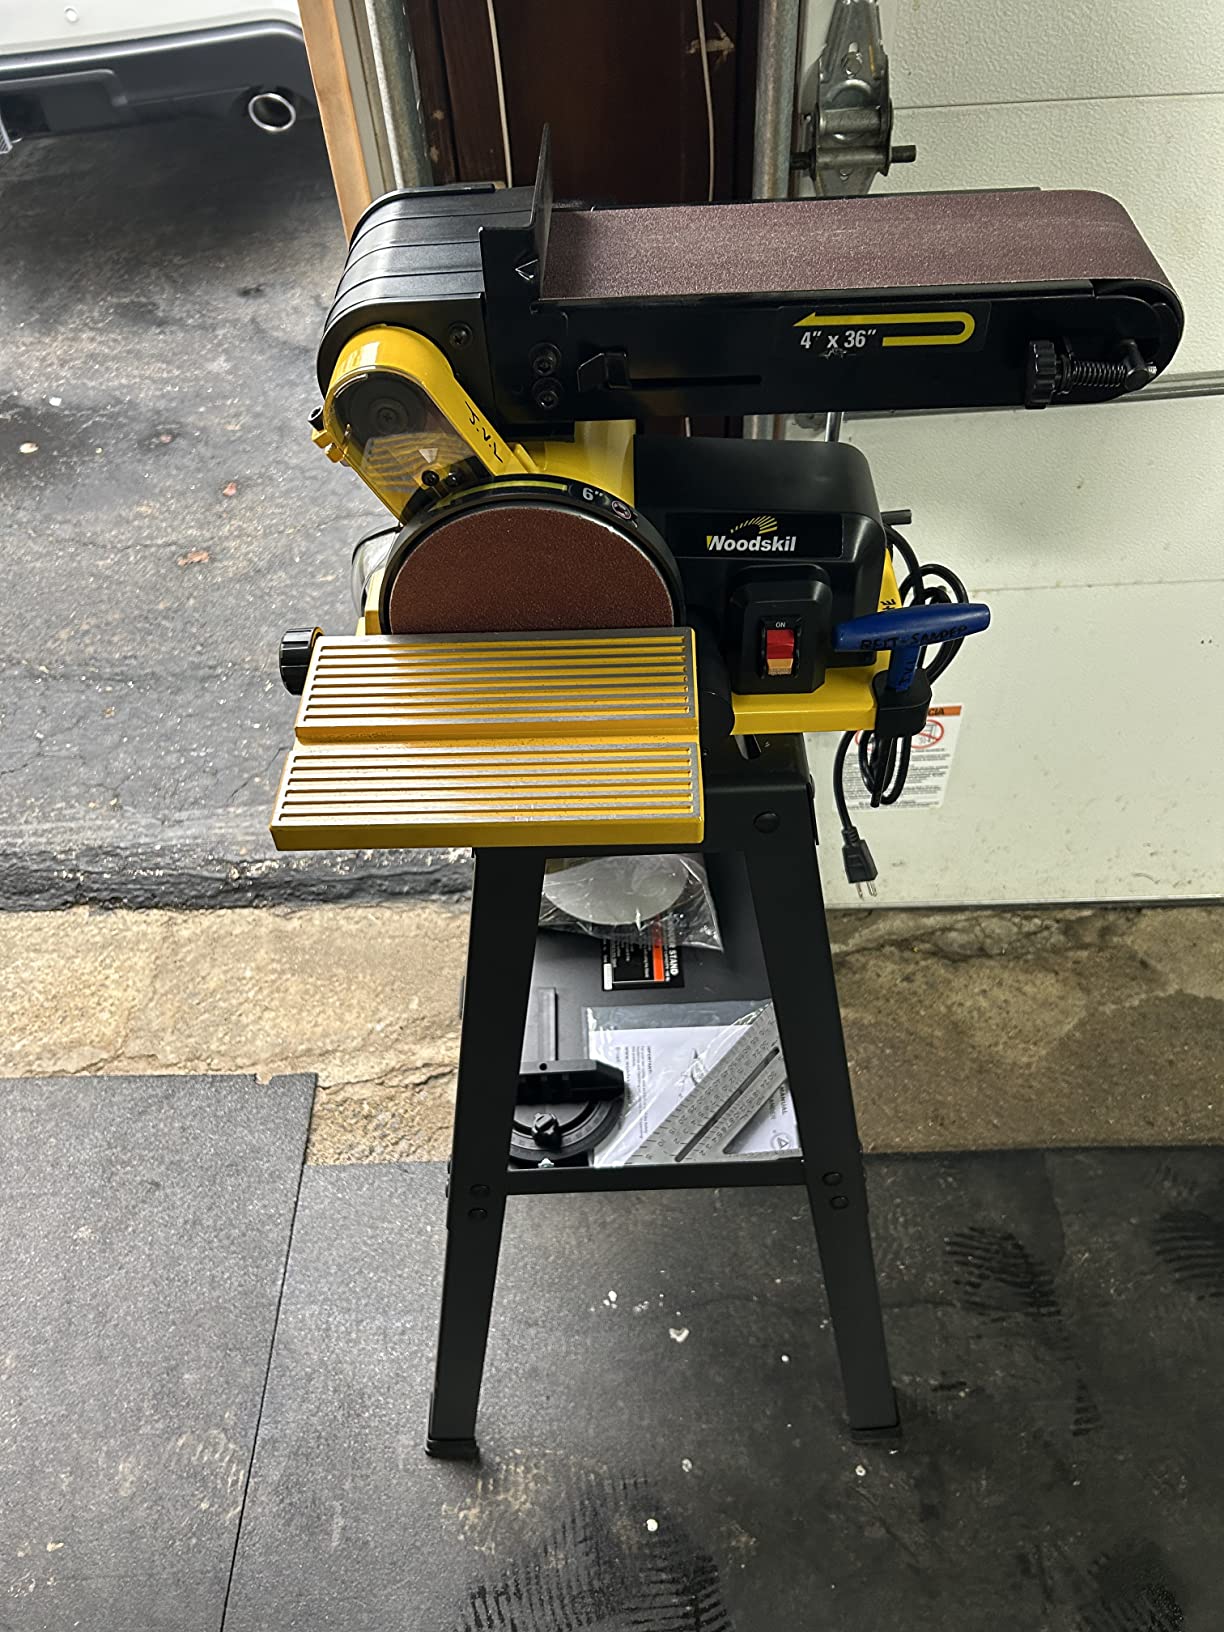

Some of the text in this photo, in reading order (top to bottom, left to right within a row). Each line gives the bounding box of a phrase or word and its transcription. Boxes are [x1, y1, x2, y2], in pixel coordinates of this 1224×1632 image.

[800, 329, 877, 348] 4" x 36"
[582, 487, 603, 501] 6"
[706, 535, 797, 552] Woodskil
[668, 950, 679, 976] STAND
